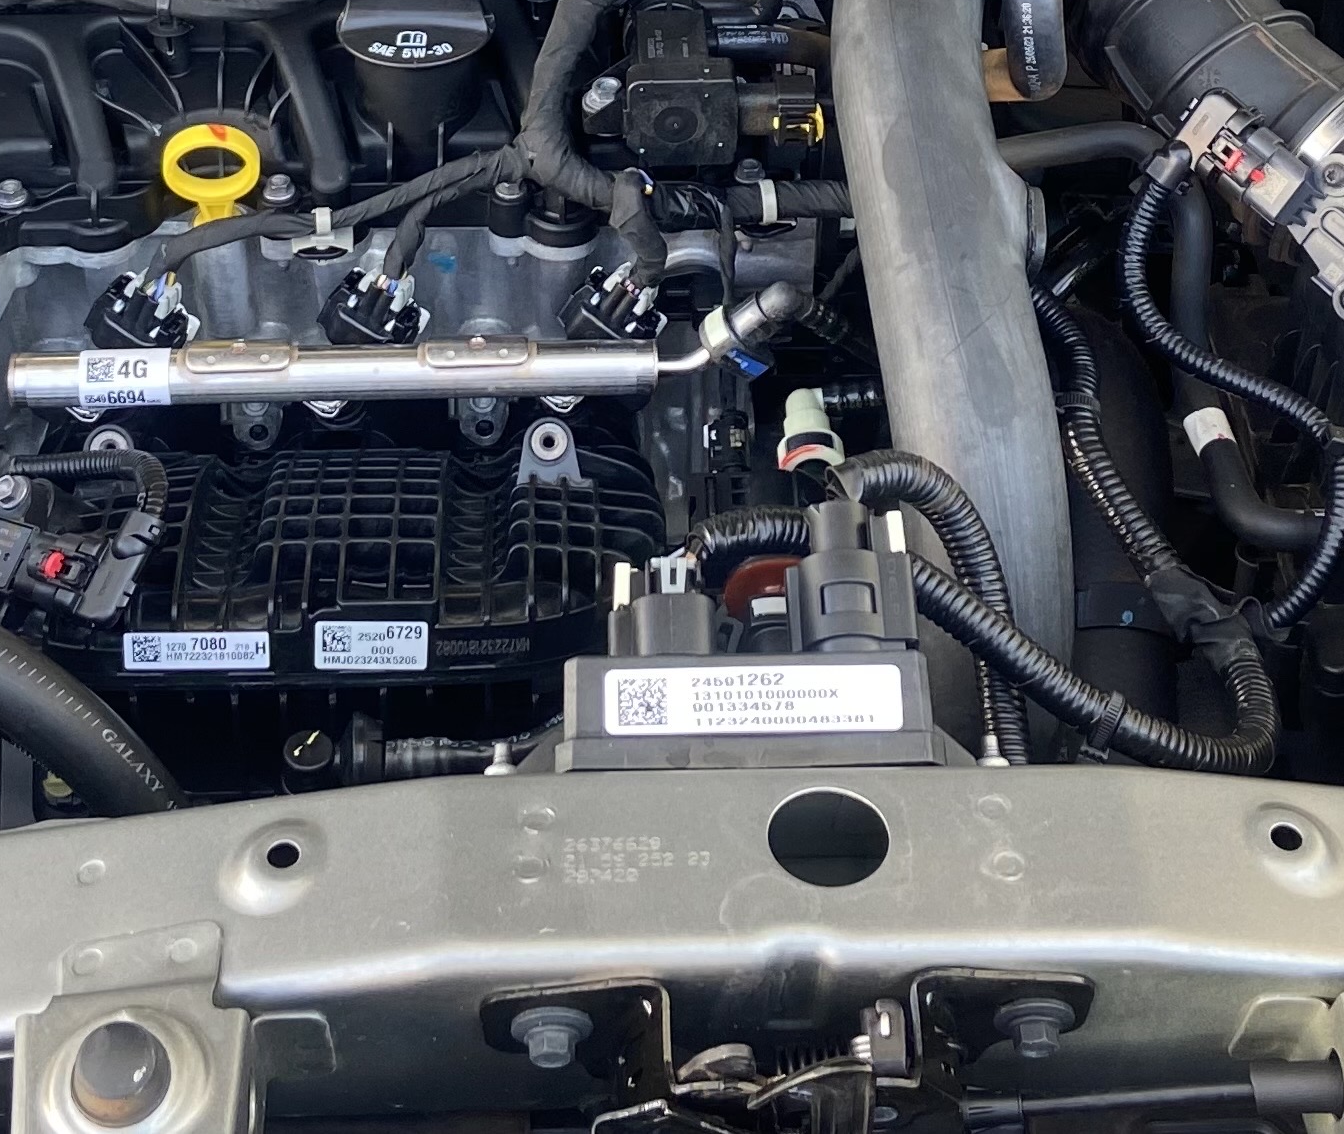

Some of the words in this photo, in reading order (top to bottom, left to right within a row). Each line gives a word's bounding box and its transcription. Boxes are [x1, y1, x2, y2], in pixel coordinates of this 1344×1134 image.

[368, 42, 397, 57] SAE
[401, 43, 453, 59] 5W-30
[117, 358, 149, 379] 4G
[190, 638, 227, 651] 7080
[255, 642, 266, 655] H
[694, 689, 839, 700] 1310101000000X
[102, 728, 164, 792] GALAXY
